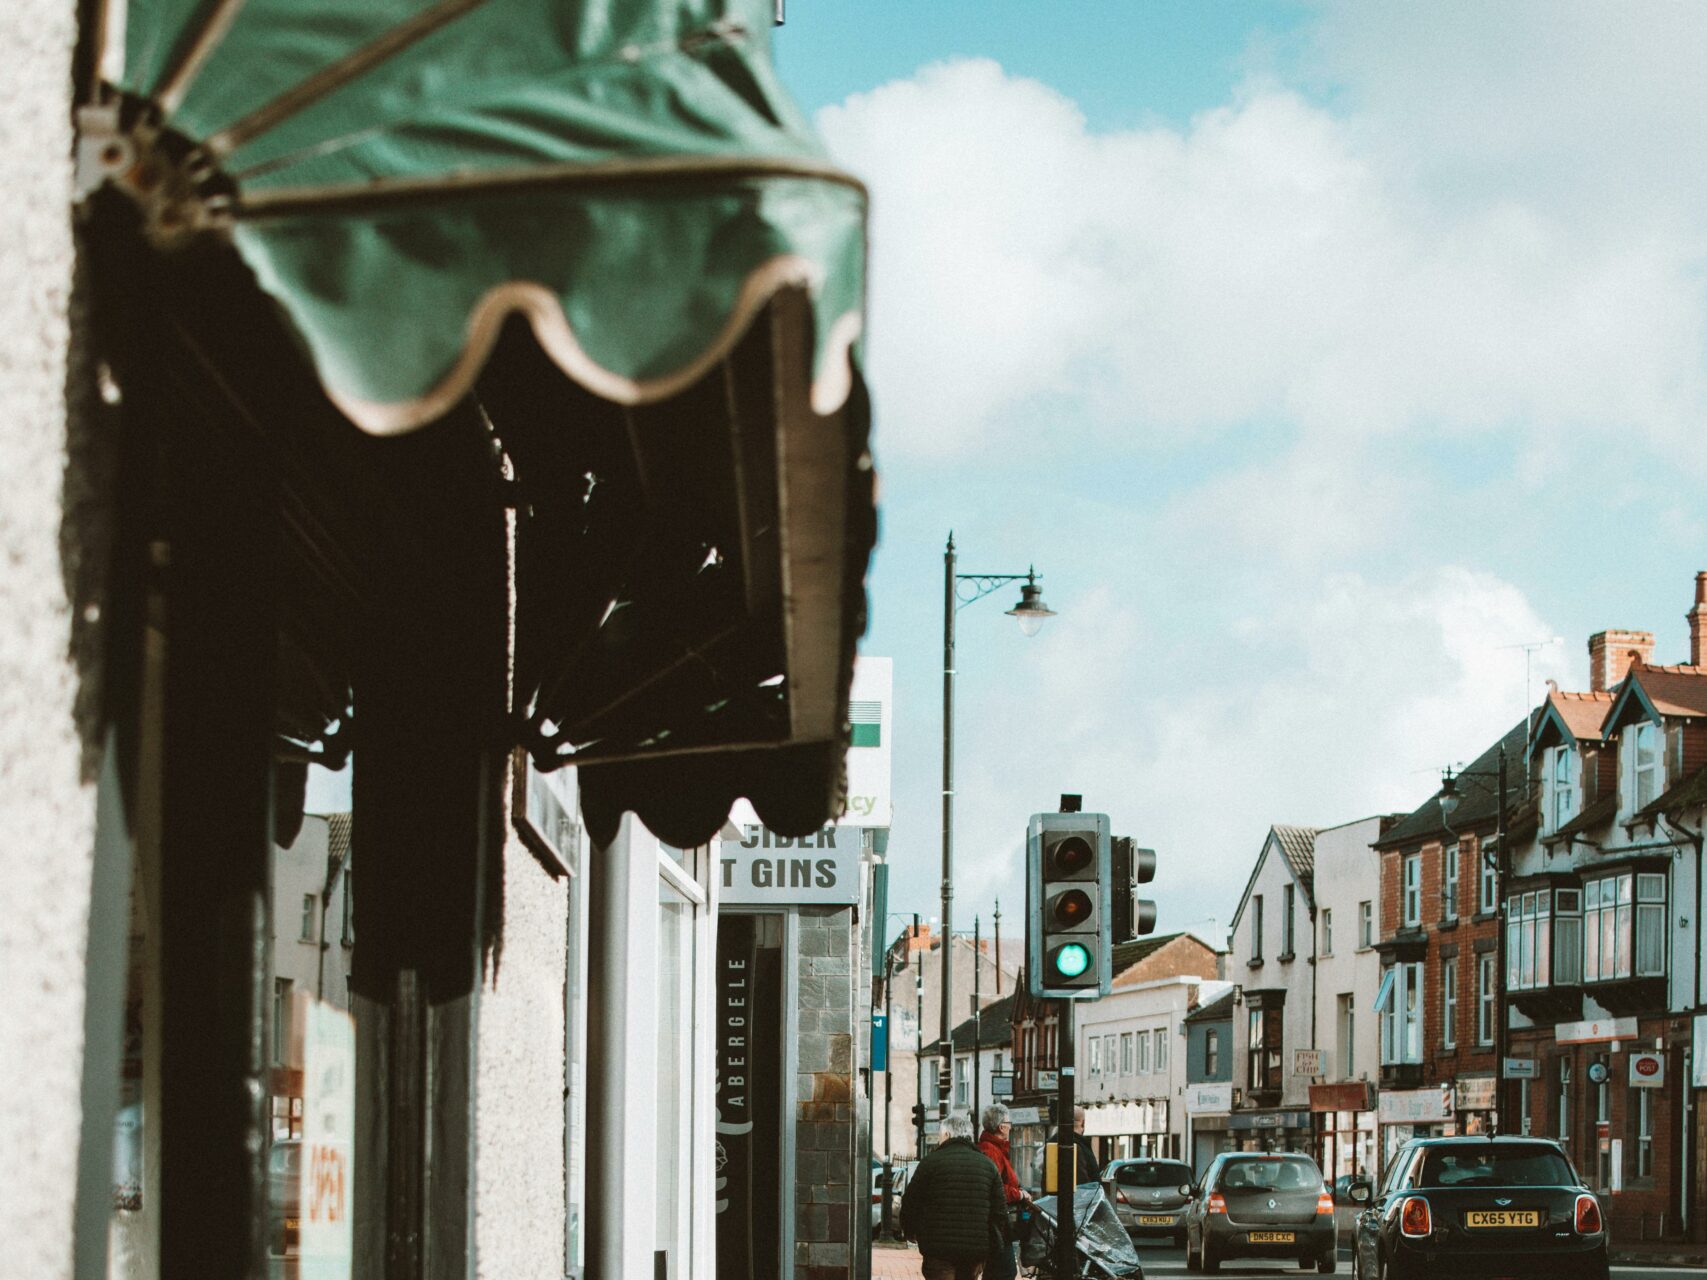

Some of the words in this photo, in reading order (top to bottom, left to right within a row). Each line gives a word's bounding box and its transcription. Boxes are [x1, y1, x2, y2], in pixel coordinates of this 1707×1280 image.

[751, 858, 837, 888] GINS
[728, 959, 745, 1107] ABERGELE
[1472, 1212, 1506, 1225] CX65
[1508, 1212, 1533, 1225] YTG
[1253, 1232, 1274, 1241] DN58
[1275, 1232, 1292, 1241] CXC
